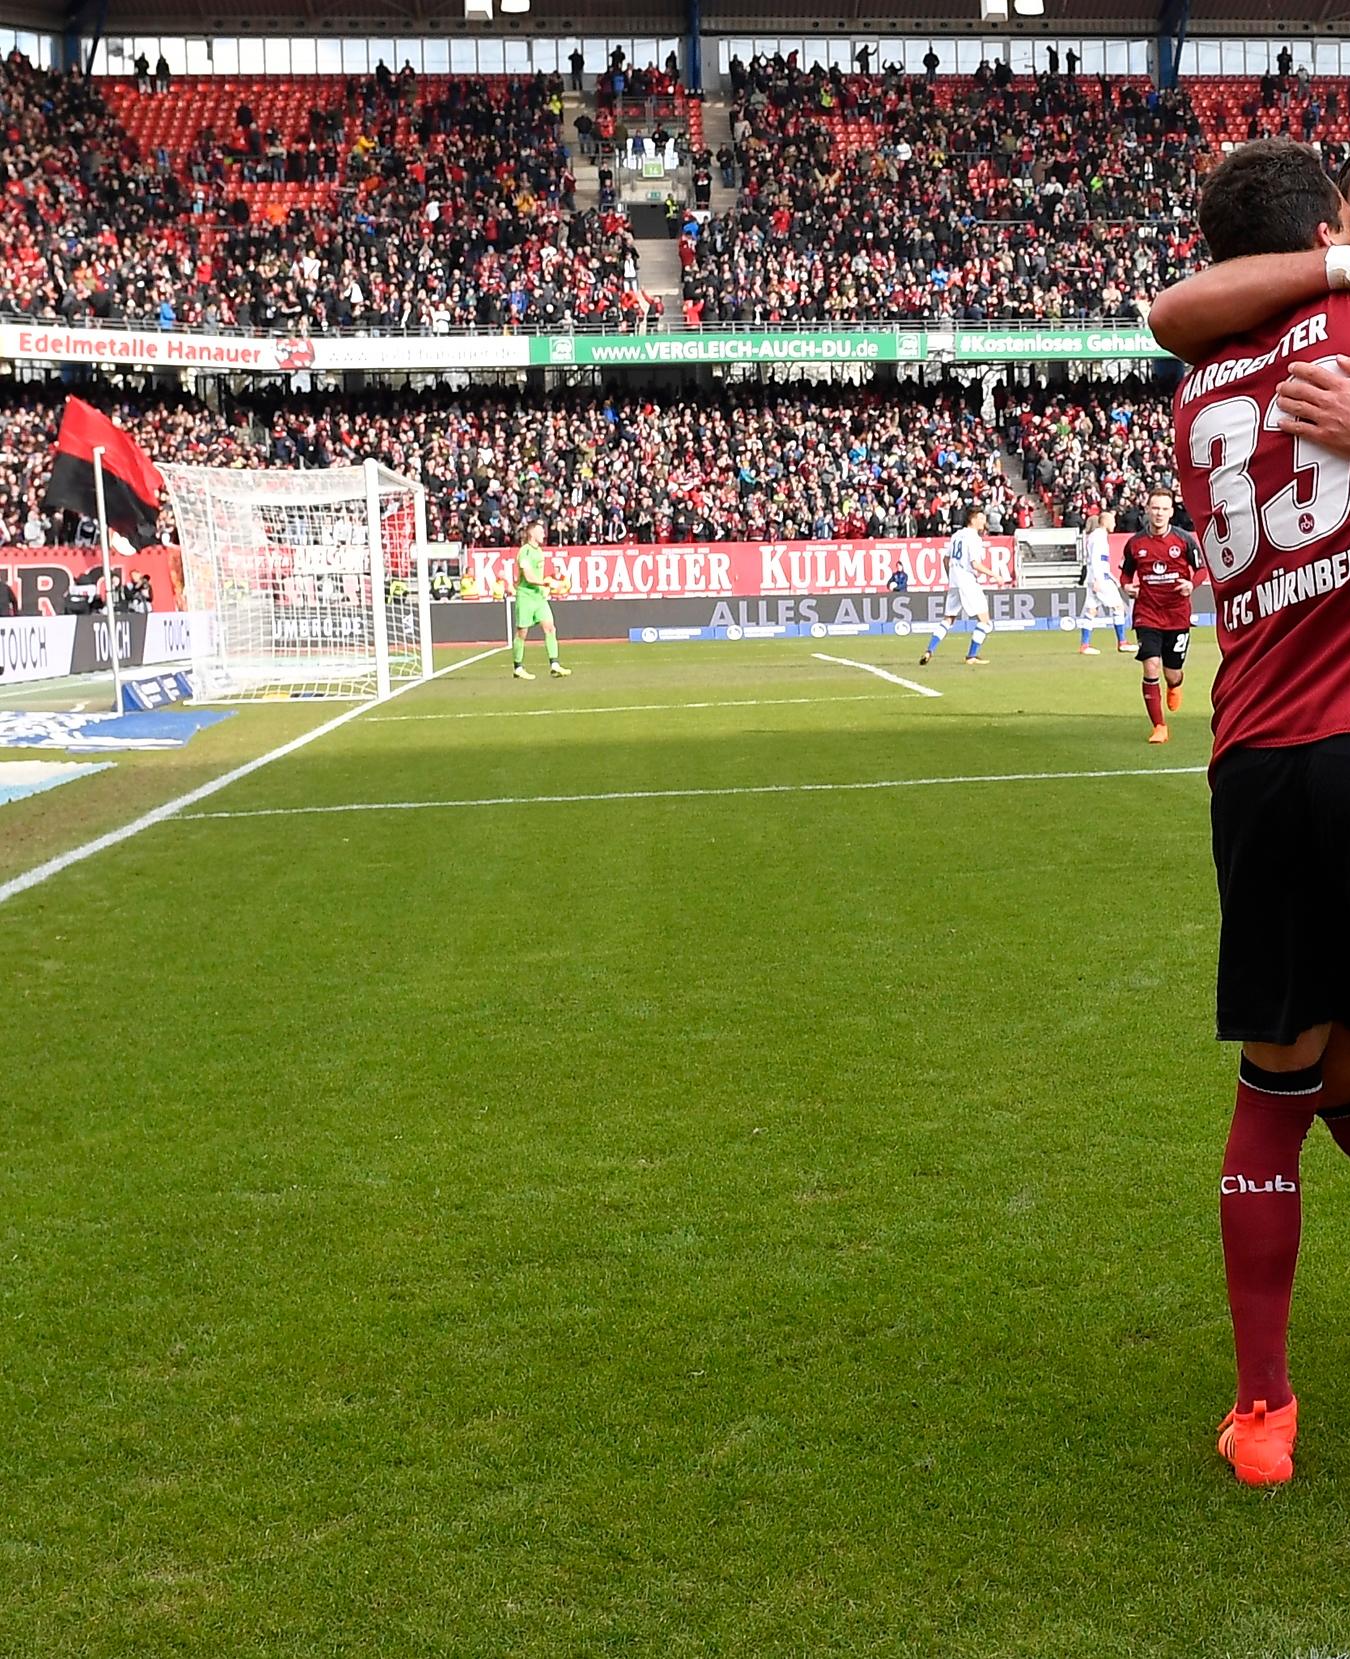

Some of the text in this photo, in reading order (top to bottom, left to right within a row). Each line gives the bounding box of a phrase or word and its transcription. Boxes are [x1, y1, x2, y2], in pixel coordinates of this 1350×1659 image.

[19, 333, 262, 363] Edelmetalle Hanauer
[591, 338, 879, 360] www.VERGLEICH-AUCH-DU.de
[960, 335, 1082, 353] #Kostenloses
[709, 598, 820, 627] ALLES
[833, 596, 913, 625] AUS
[1220, 1173, 1297, 1195] Club
